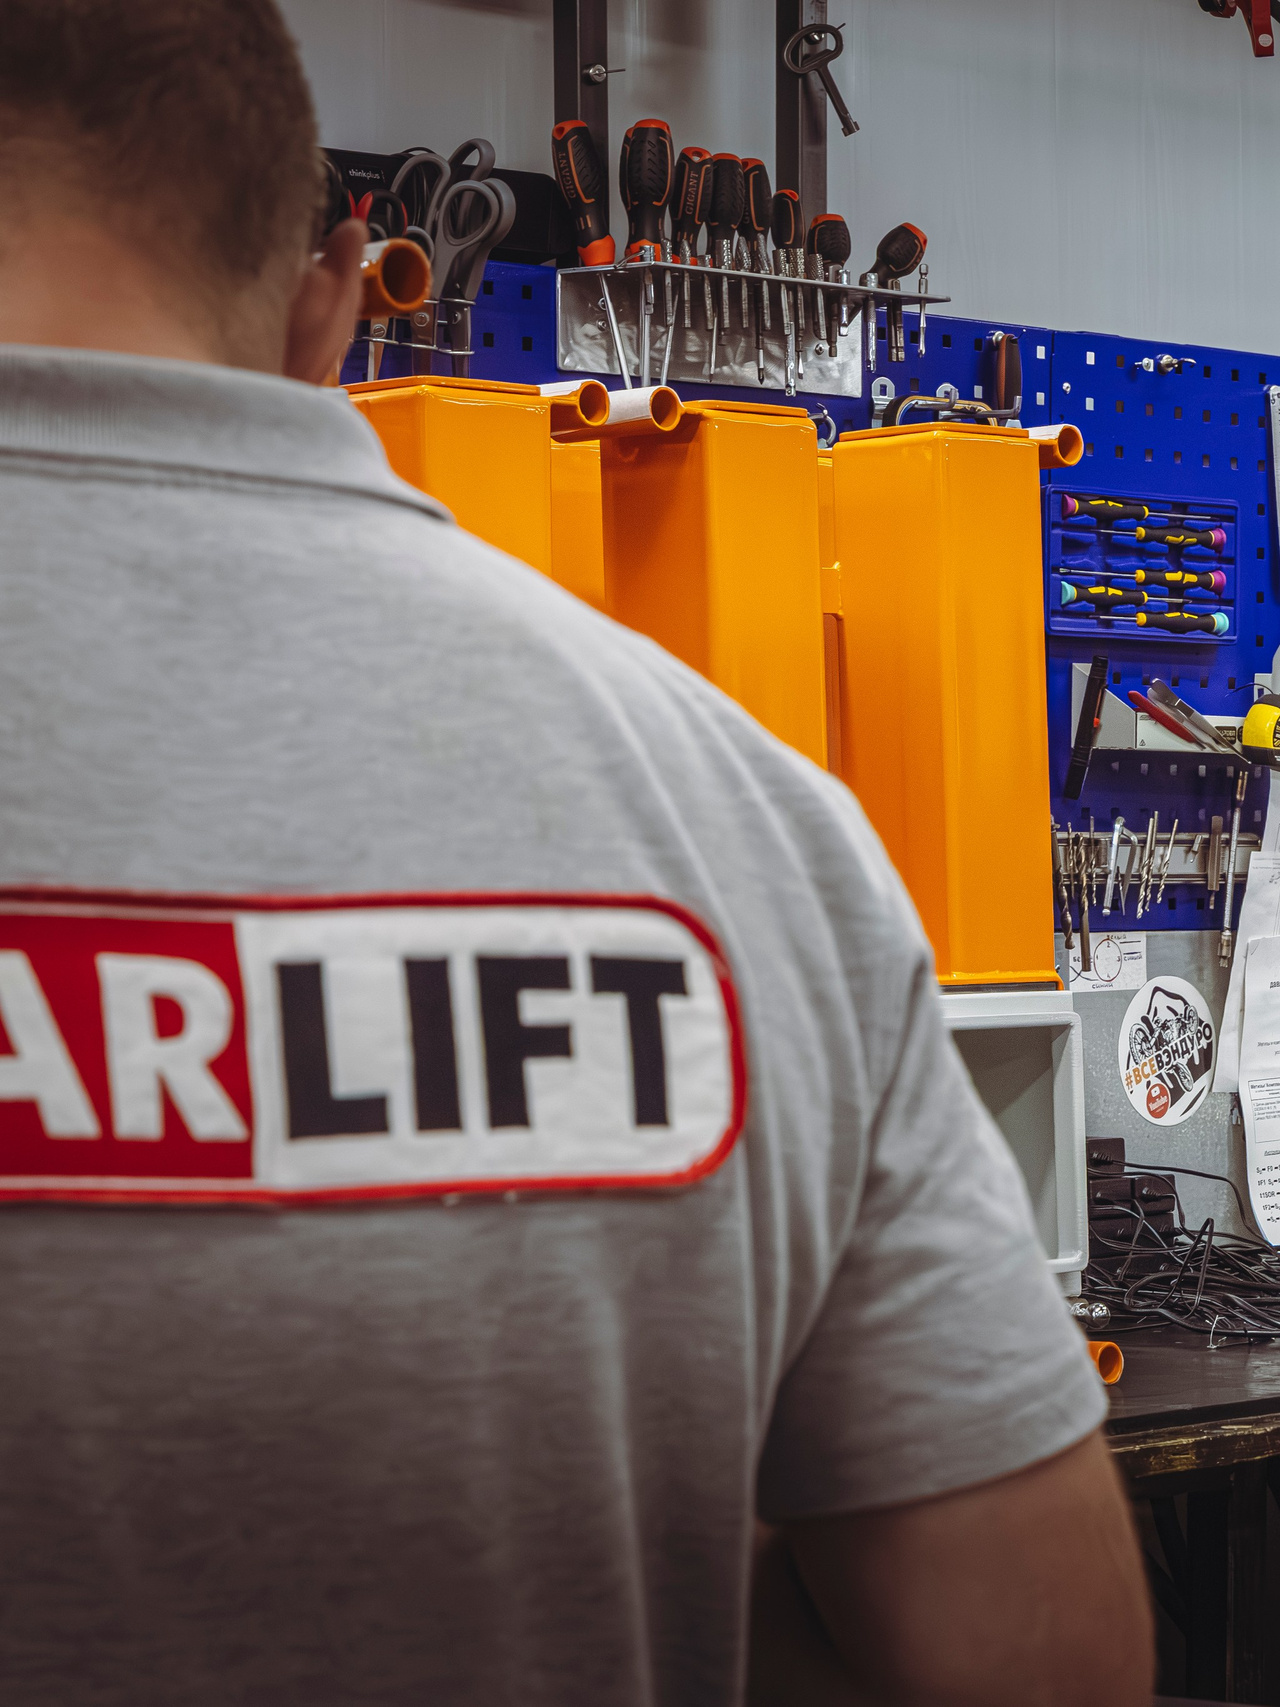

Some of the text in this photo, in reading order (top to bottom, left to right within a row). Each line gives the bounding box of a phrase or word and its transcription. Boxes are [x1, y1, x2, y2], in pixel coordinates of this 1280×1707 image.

[349, 169, 381, 180] thinkplus
[559, 151, 576, 199] GIGANT
[685, 171, 700, 215] GIGANT
